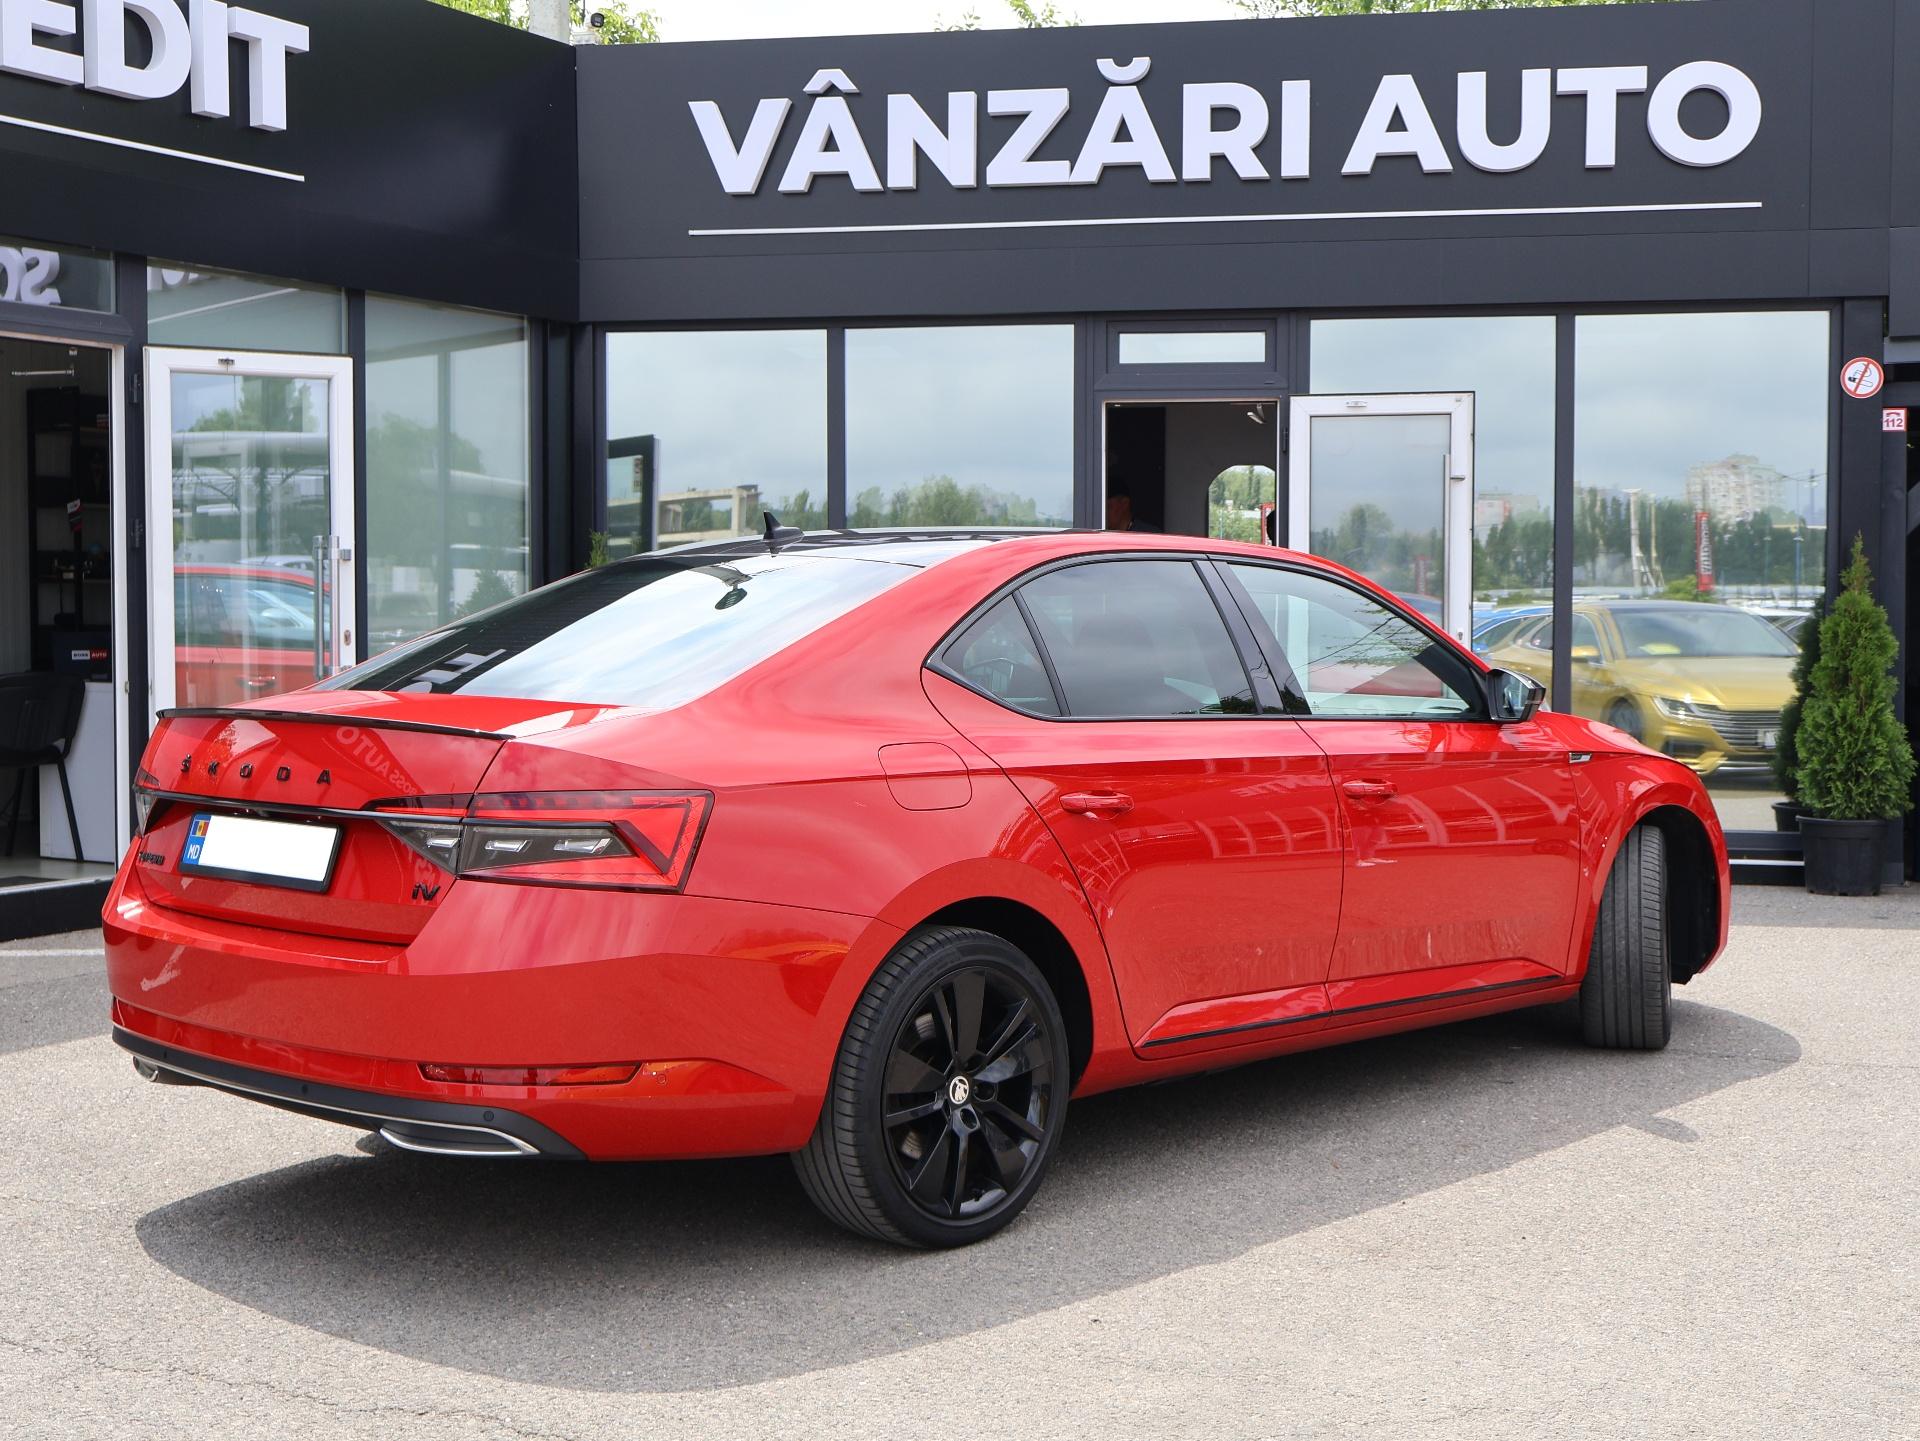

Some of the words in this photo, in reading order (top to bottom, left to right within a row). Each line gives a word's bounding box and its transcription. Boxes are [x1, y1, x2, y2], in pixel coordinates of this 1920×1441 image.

[688, 56, 1310, 195] VÂNZĂRI
[1341, 60, 1762, 175] AUTO
[1884, 418, 1903, 428] 112
[187, 843, 200, 860] MD
